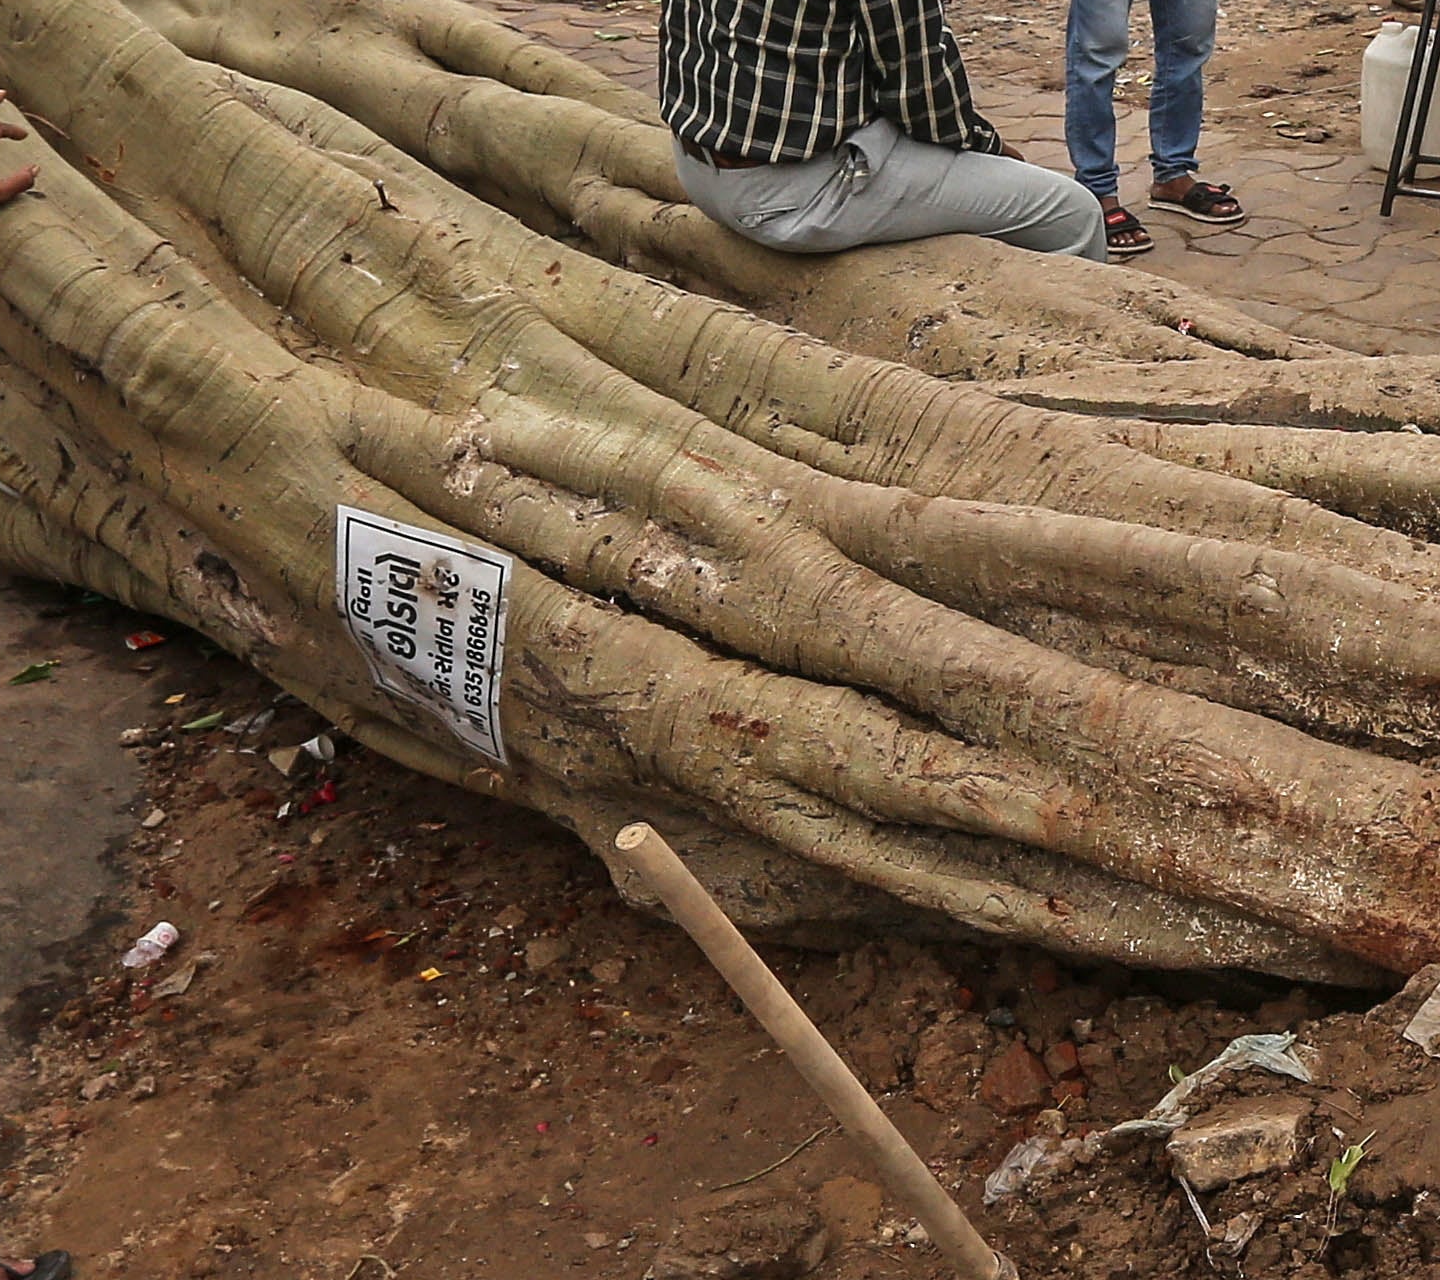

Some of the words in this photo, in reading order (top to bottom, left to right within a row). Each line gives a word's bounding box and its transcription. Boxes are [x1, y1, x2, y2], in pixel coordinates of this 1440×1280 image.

[350, 567, 373, 623] વિના
[373, 552, 421, 660] છોડાવો
[464, 587, 492, 708] 6351866845
